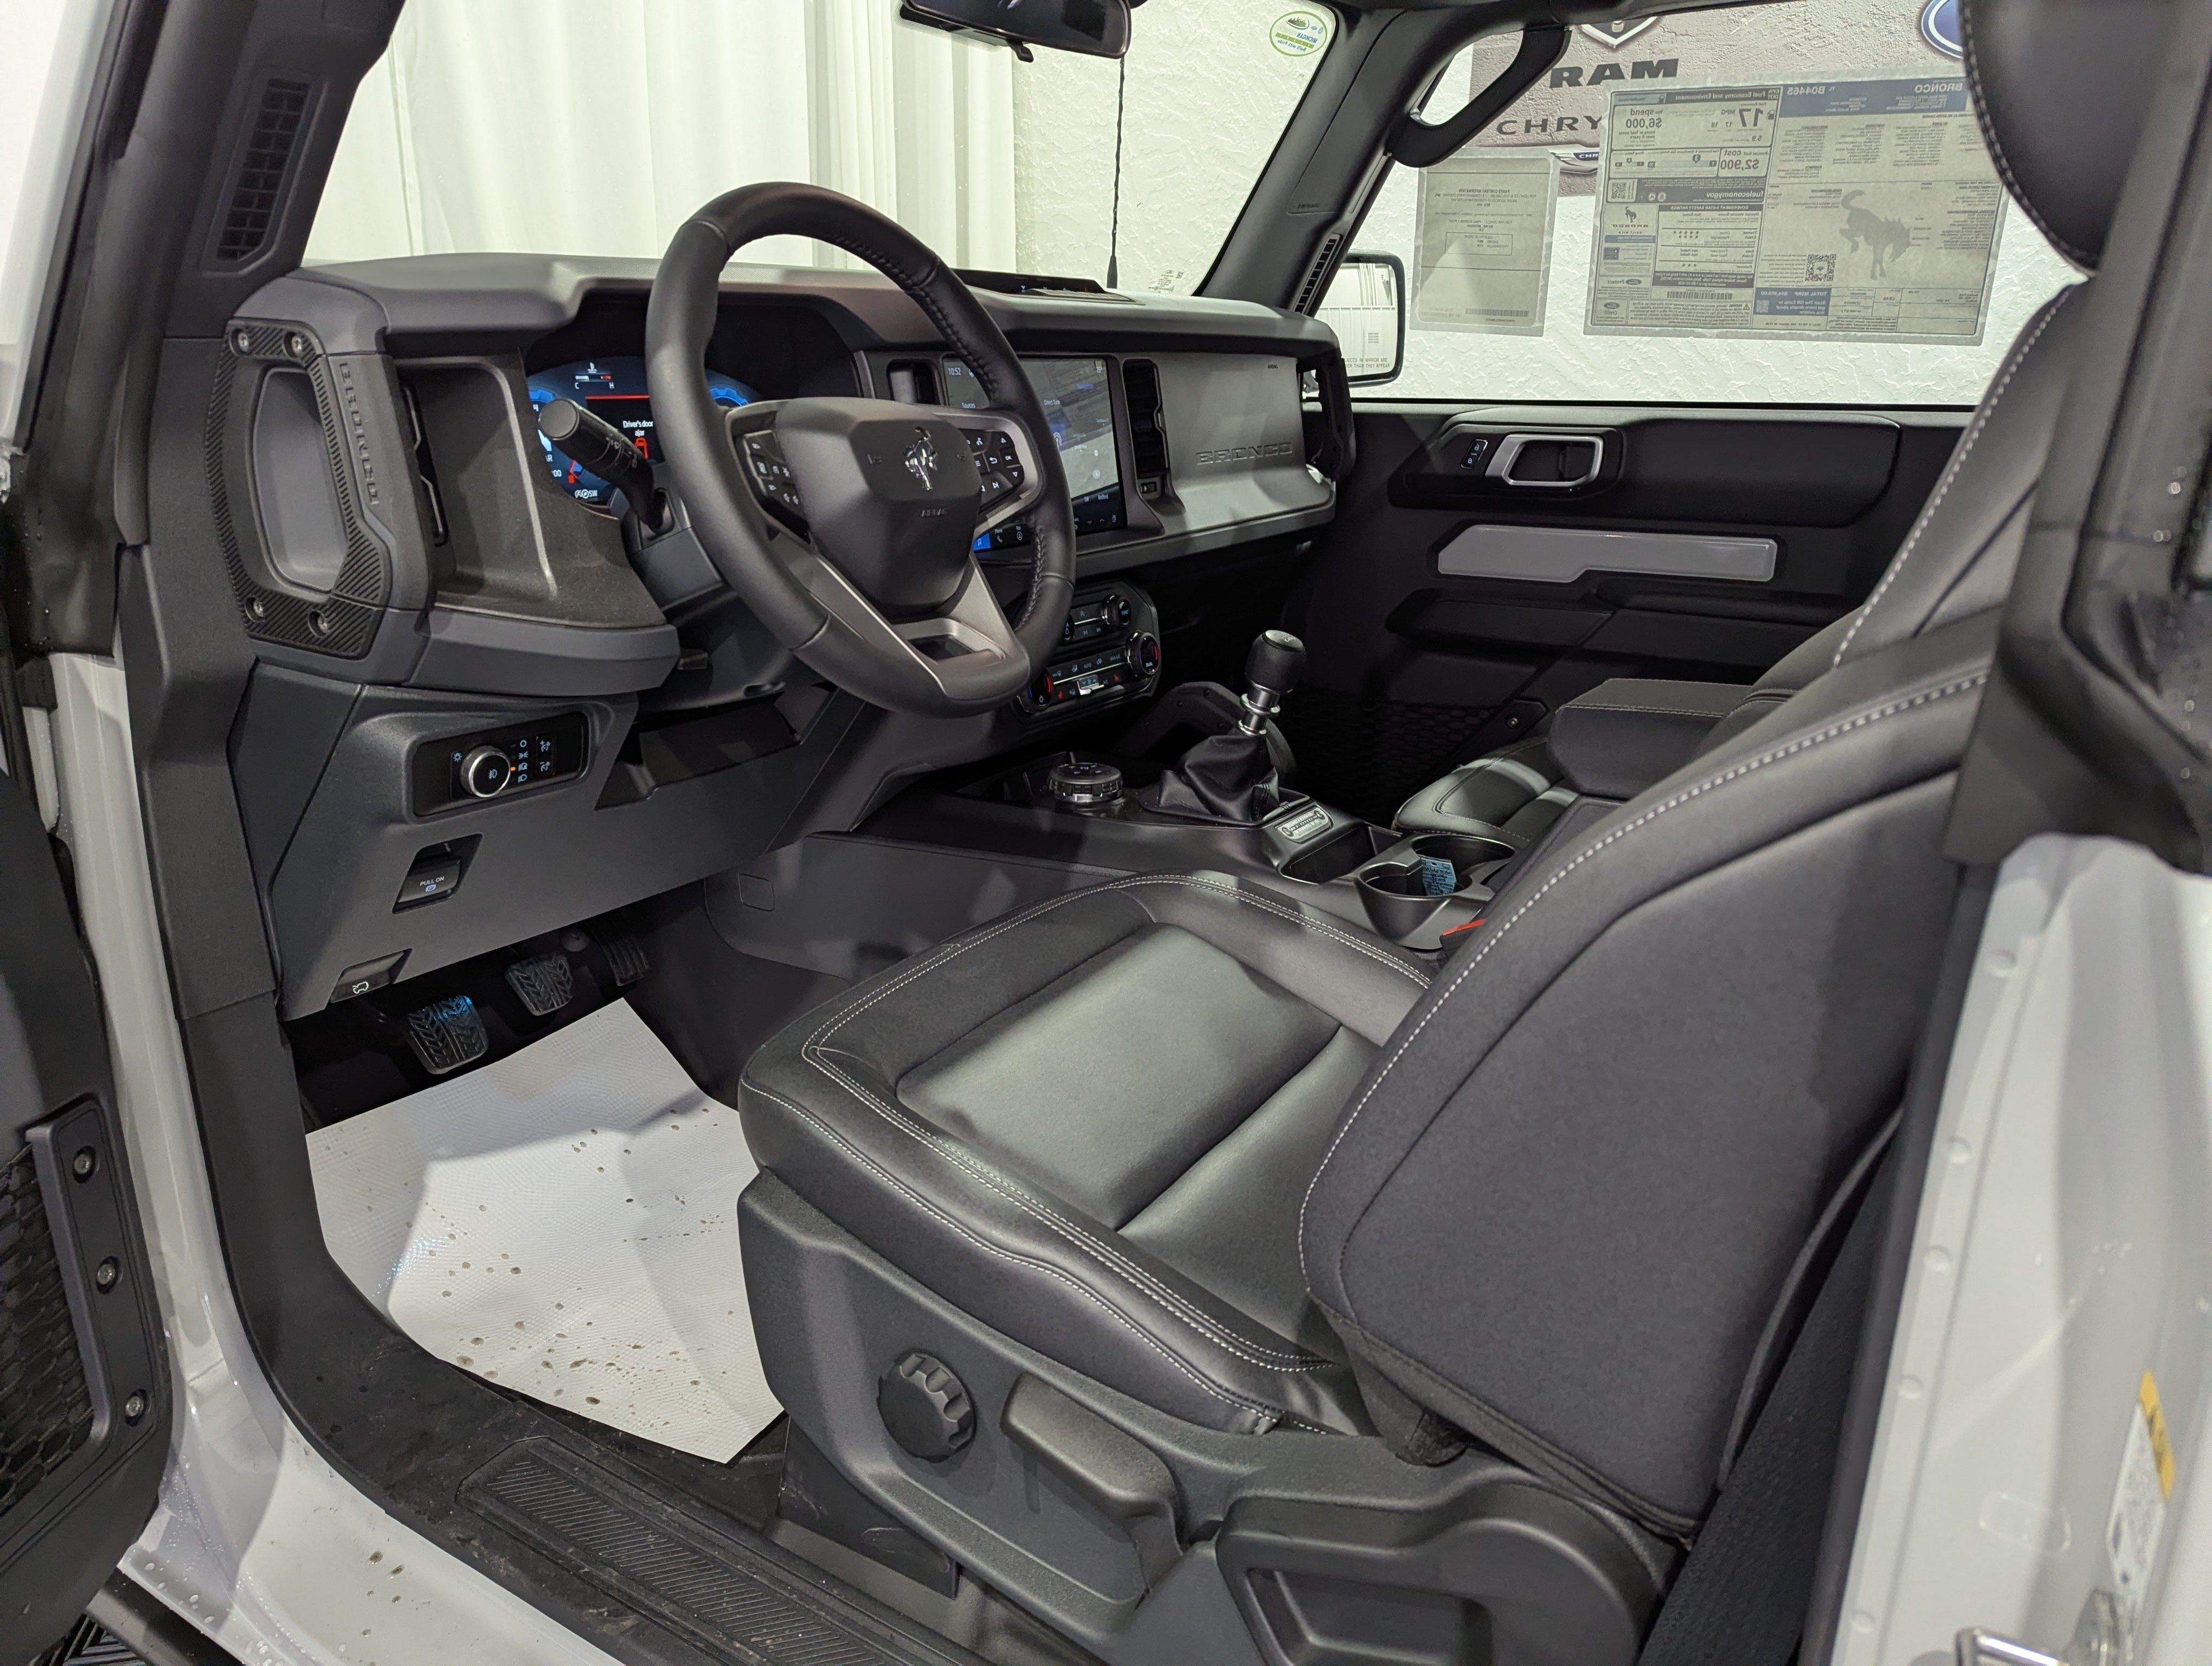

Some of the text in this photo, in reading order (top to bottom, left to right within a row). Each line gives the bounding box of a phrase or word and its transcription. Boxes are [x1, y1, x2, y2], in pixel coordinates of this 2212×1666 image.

[1550, 58, 1679, 88] RAM
[575, 382, 580, 390] C
[340, 362, 380, 505] BRONCO
[634, 429, 645, 437] ajar
[1195, 442, 1293, 465] BRONCO
[420, 879, 435, 887] PULL
